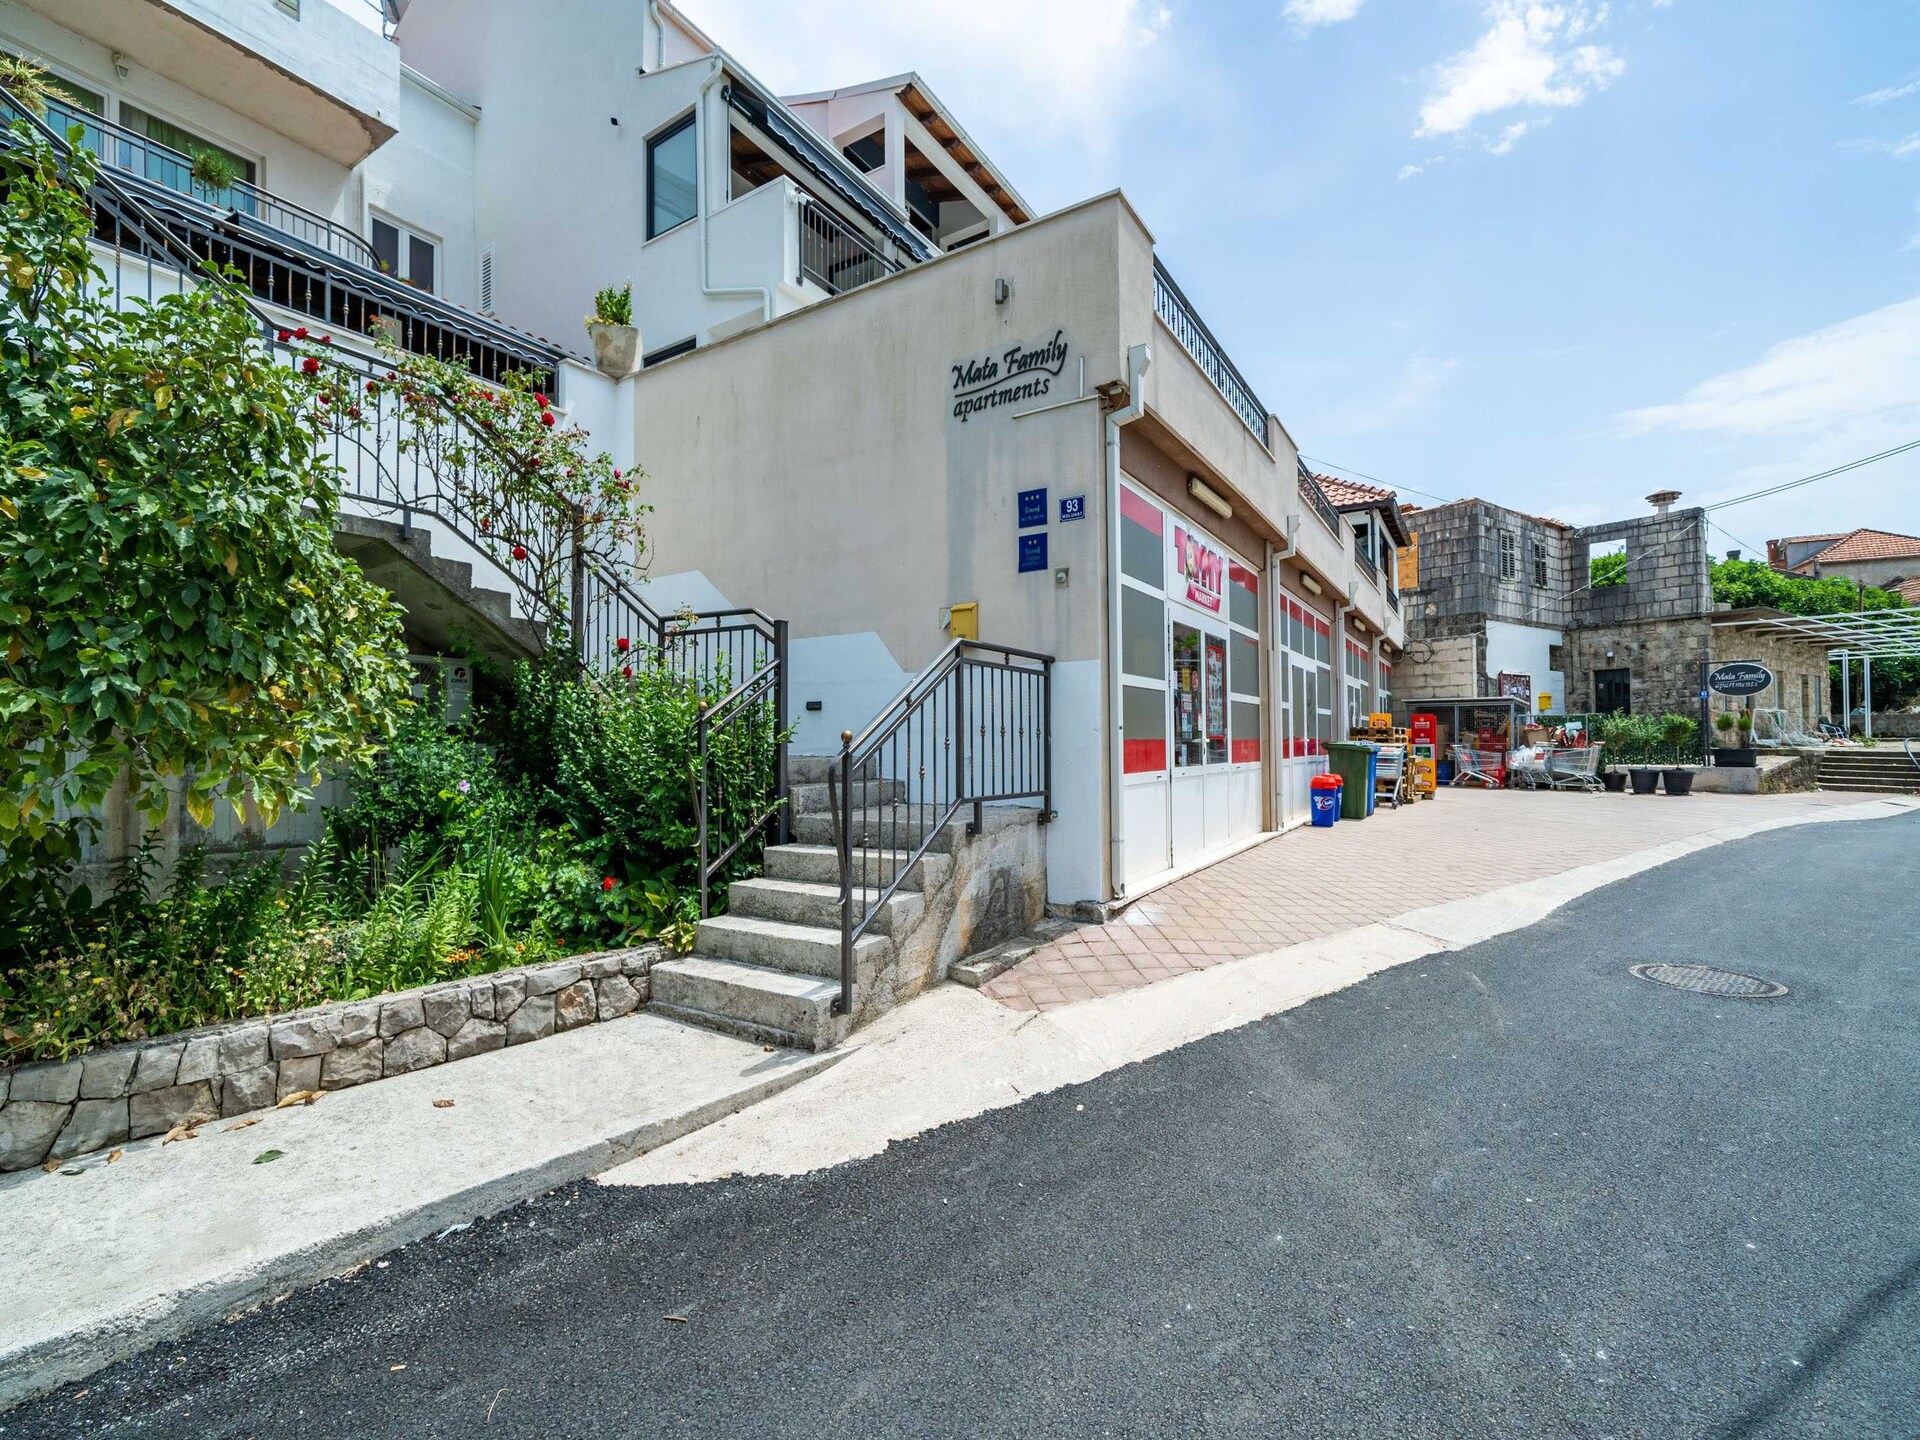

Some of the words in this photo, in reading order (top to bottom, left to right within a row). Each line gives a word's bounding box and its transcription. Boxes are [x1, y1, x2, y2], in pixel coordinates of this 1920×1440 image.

[951, 356, 999, 390] Mata
[1003, 329, 1068, 377] Family
[953, 377, 1051, 423] apartments
[1066, 499, 1079, 513] 93
[1737, 669, 1766, 683] Family
[1714, 681, 1758, 690] apartments
